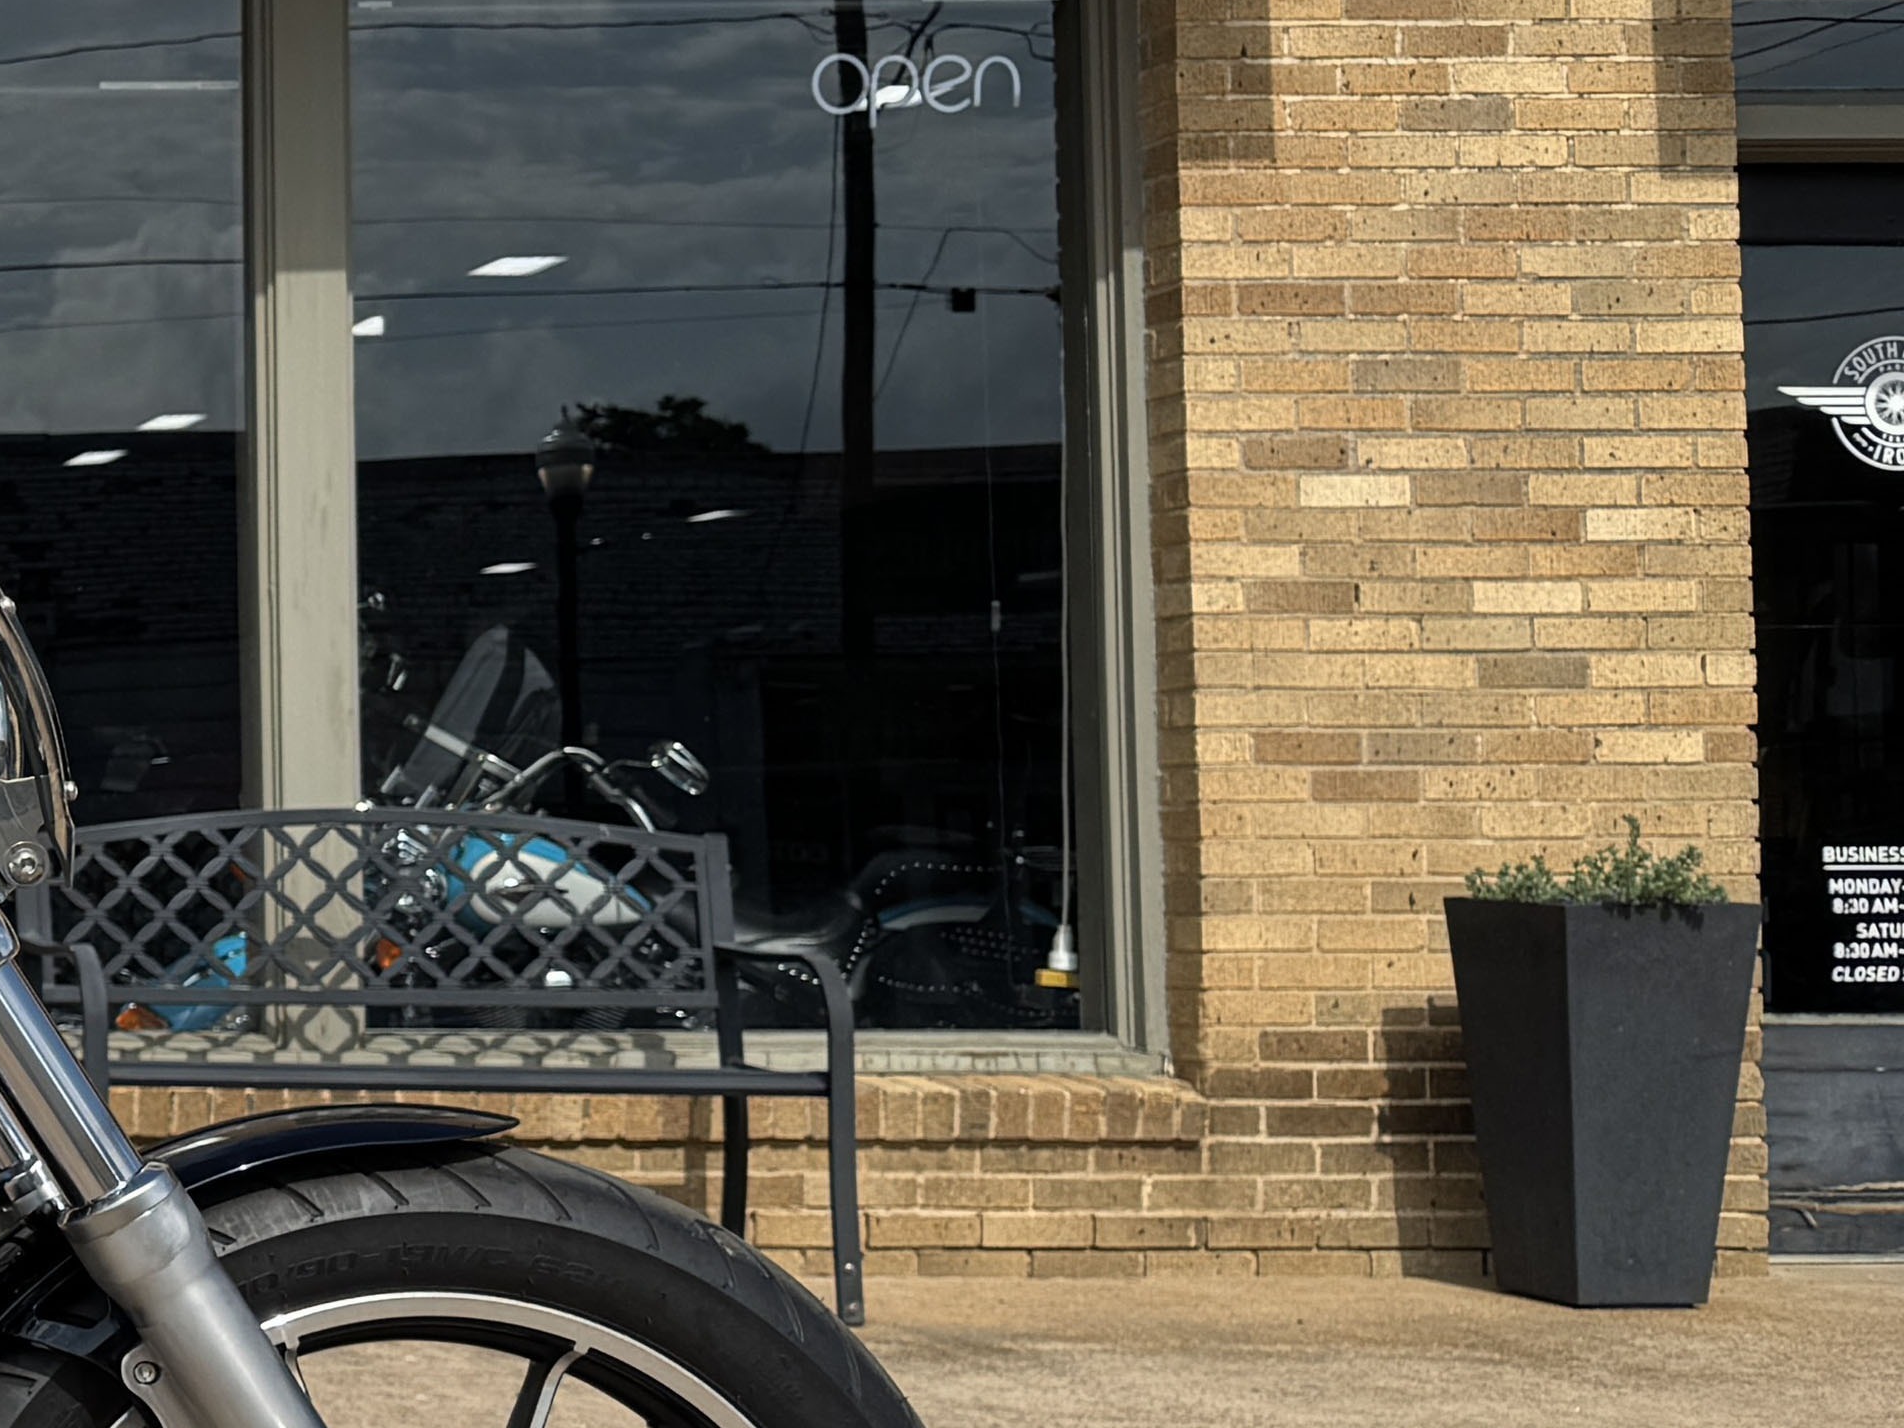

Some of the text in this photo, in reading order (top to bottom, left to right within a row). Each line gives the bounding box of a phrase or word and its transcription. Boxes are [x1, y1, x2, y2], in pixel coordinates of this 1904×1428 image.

[812, 52, 1021, 129] open
[1844, 341, 1898, 381] SOUTH
[1832, 897, 1869, 914] 8:30
[1856, 922, 1904, 939] SATU
[1832, 942, 1870, 959] 8:30
[1831, 966, 1900, 983] CLOSED
